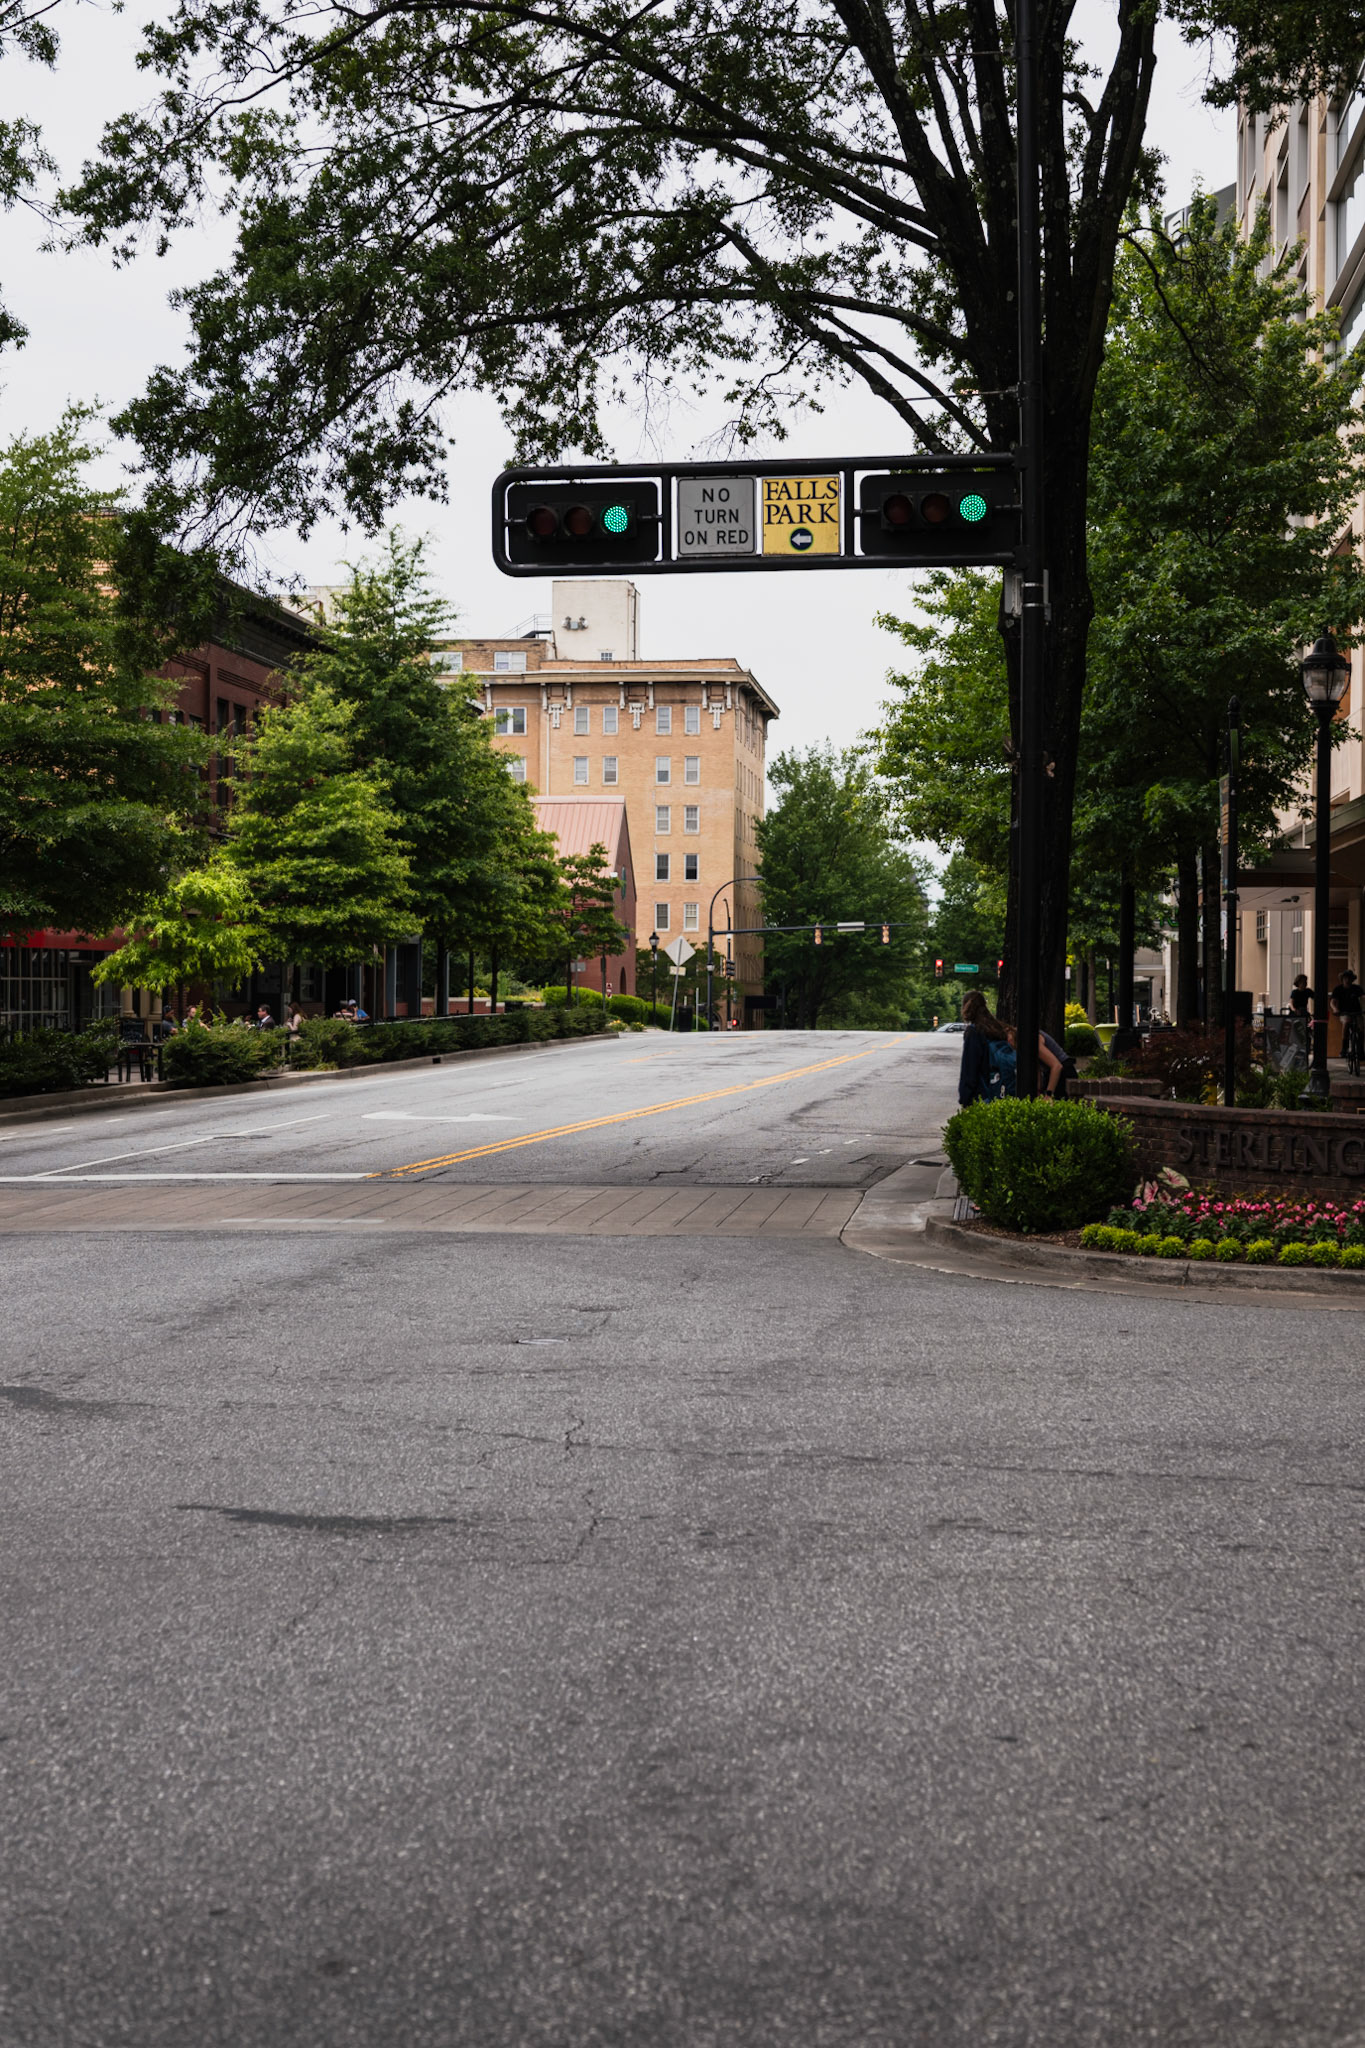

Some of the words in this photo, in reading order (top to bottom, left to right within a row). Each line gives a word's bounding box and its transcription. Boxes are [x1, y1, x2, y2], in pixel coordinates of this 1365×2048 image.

[702, 488, 730, 503] NO
[764, 480, 838, 501] FALLS
[694, 508, 739, 524] TURN
[764, 503, 838, 525] PARK
[684, 531, 707, 545] ON
[717, 530, 749, 545] RED
[1178, 1125, 1365, 1177] STERLING
